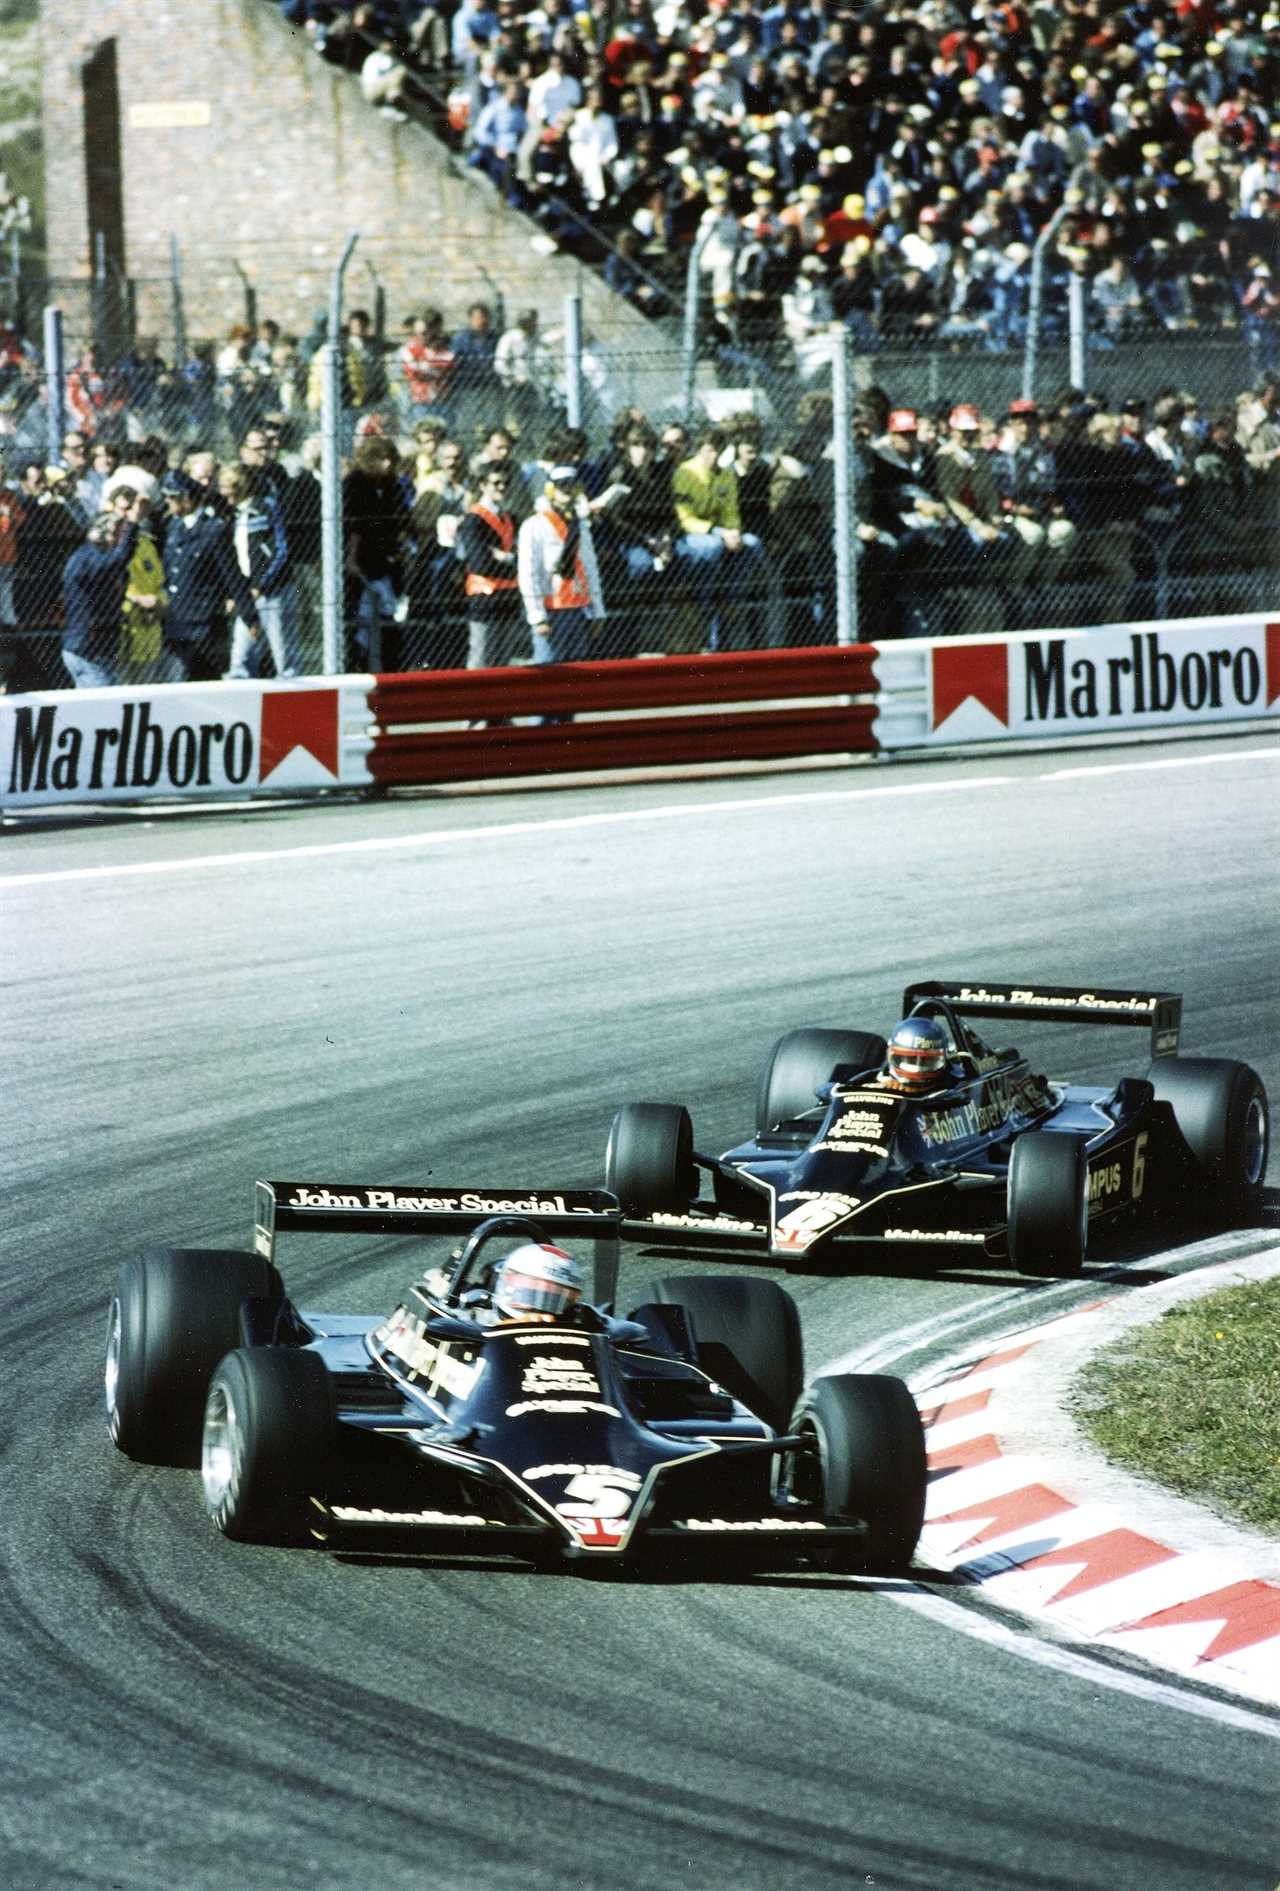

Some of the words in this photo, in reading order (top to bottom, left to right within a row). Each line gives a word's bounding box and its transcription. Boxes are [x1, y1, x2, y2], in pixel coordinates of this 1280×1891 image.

[1022, 633, 1261, 721] Marlboro
[7, 702, 252, 793] Marlboro
[960, 988, 1005, 1003] John
[1087, 1162, 1121, 1201] MPUS
[1131, 1130, 1149, 1199] 6
[288, 1188, 363, 1208] John
[366, 1190, 458, 1211] Player
[460, 1193, 567, 1214] Special
[554, 1472, 643, 1519] 5
